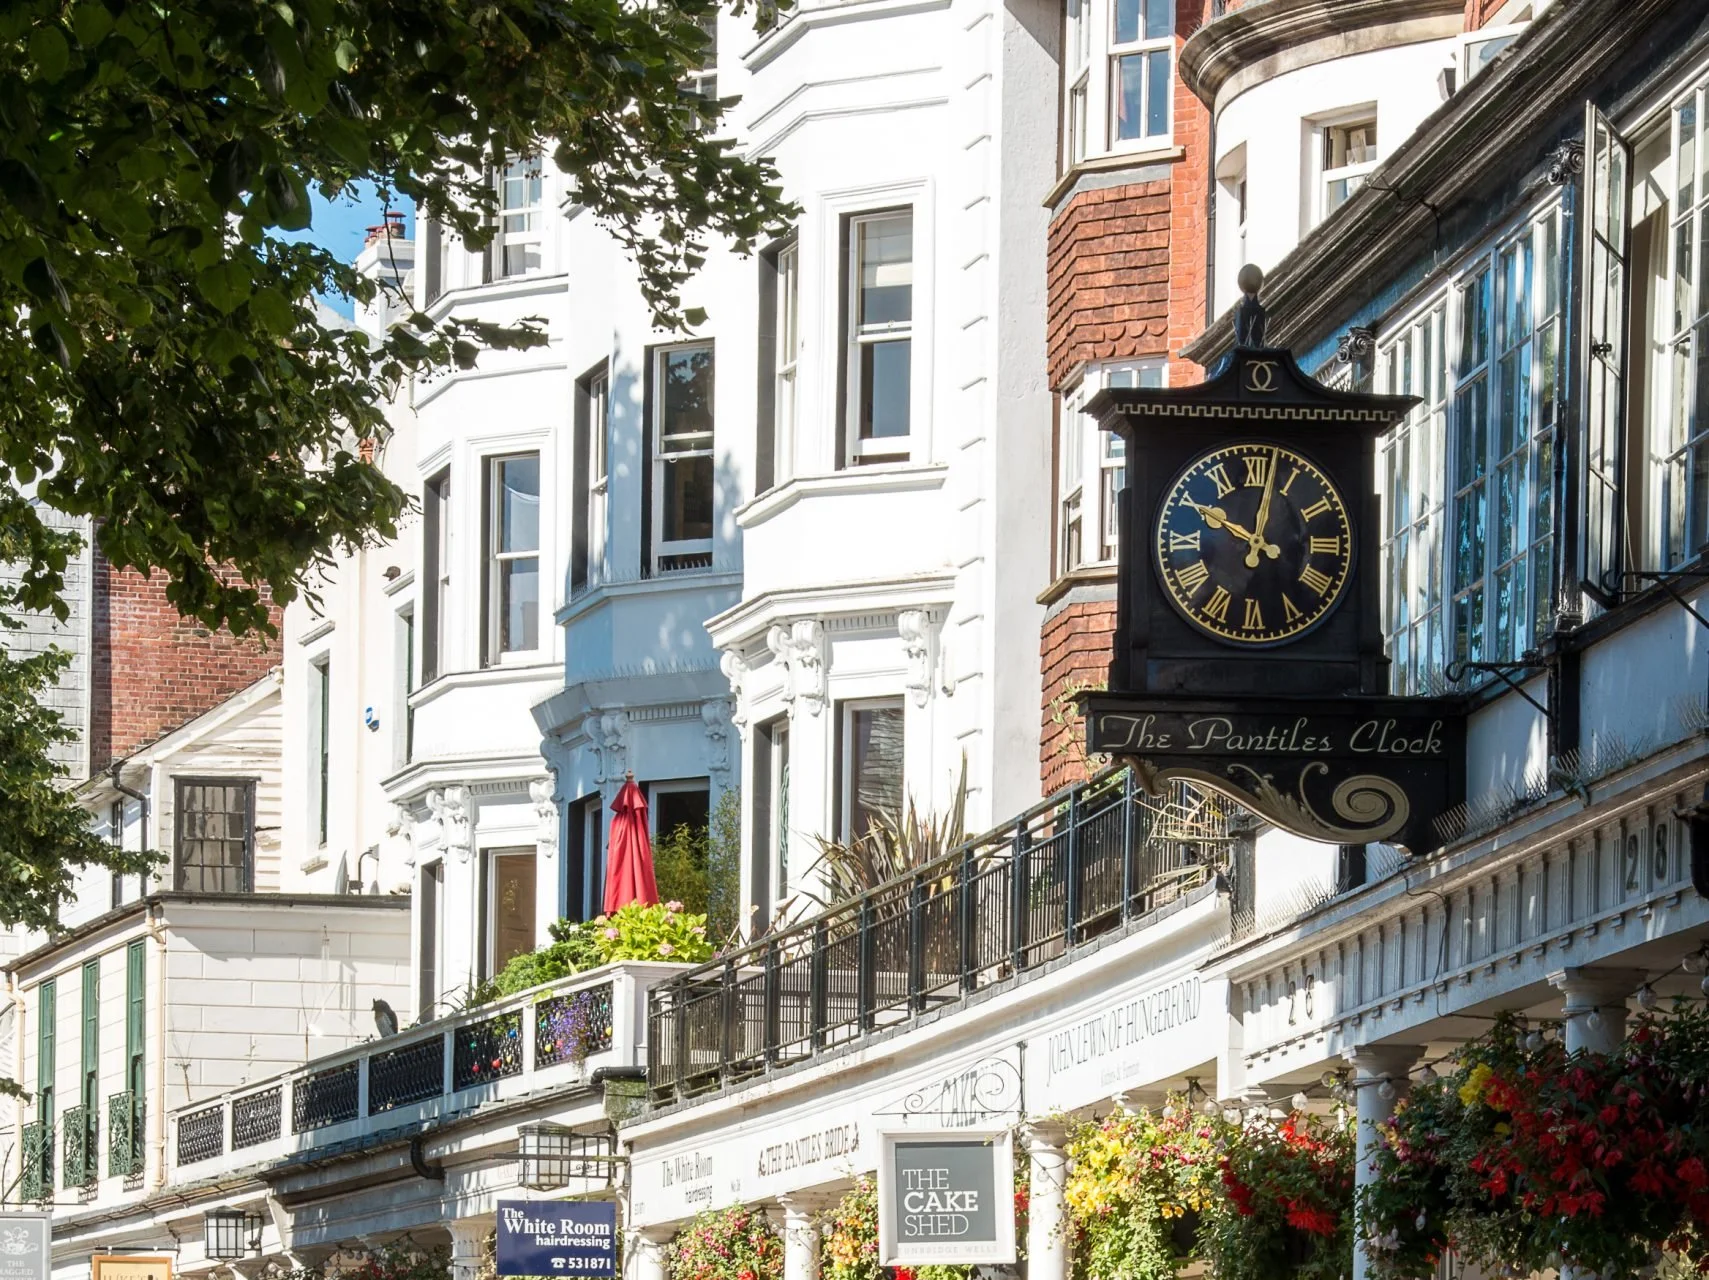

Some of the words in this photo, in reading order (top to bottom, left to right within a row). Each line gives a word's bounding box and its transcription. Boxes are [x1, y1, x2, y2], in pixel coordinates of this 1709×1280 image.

[1203, 462, 1236, 499] XI
[1242, 456, 1268, 487] XII
[1169, 530, 1201, 553] IX
[1310, 535, 1340, 556] III
[1100, 714, 1172, 749] The
[1186, 716, 1334, 752] Pantiles
[1349, 719, 1444, 754] Clock
[1046, 1028, 1075, 1087] JOHN
[1077, 1014, 1106, 1065] LEWIS
[1109, 1008, 1124, 1052] OF
[1126, 976, 1201, 1046] HUNGERFORD
[766, 1143, 783, 1176] THE
[785, 1132, 822, 1171] PANTILES
[824, 1125, 850, 1160] BRIDE
[902, 1168, 949, 1190] THE
[502, 1207, 524, 1219] The
[903, 1191, 978, 1214] CAKE
[504, 1218, 556, 1234] White
[560, 1219, 611, 1235] Room
[904, 1214, 969, 1237] SHED
[535, 1235, 611, 1249] hairdressing
[568, 1258, 611, 1269] 531871
